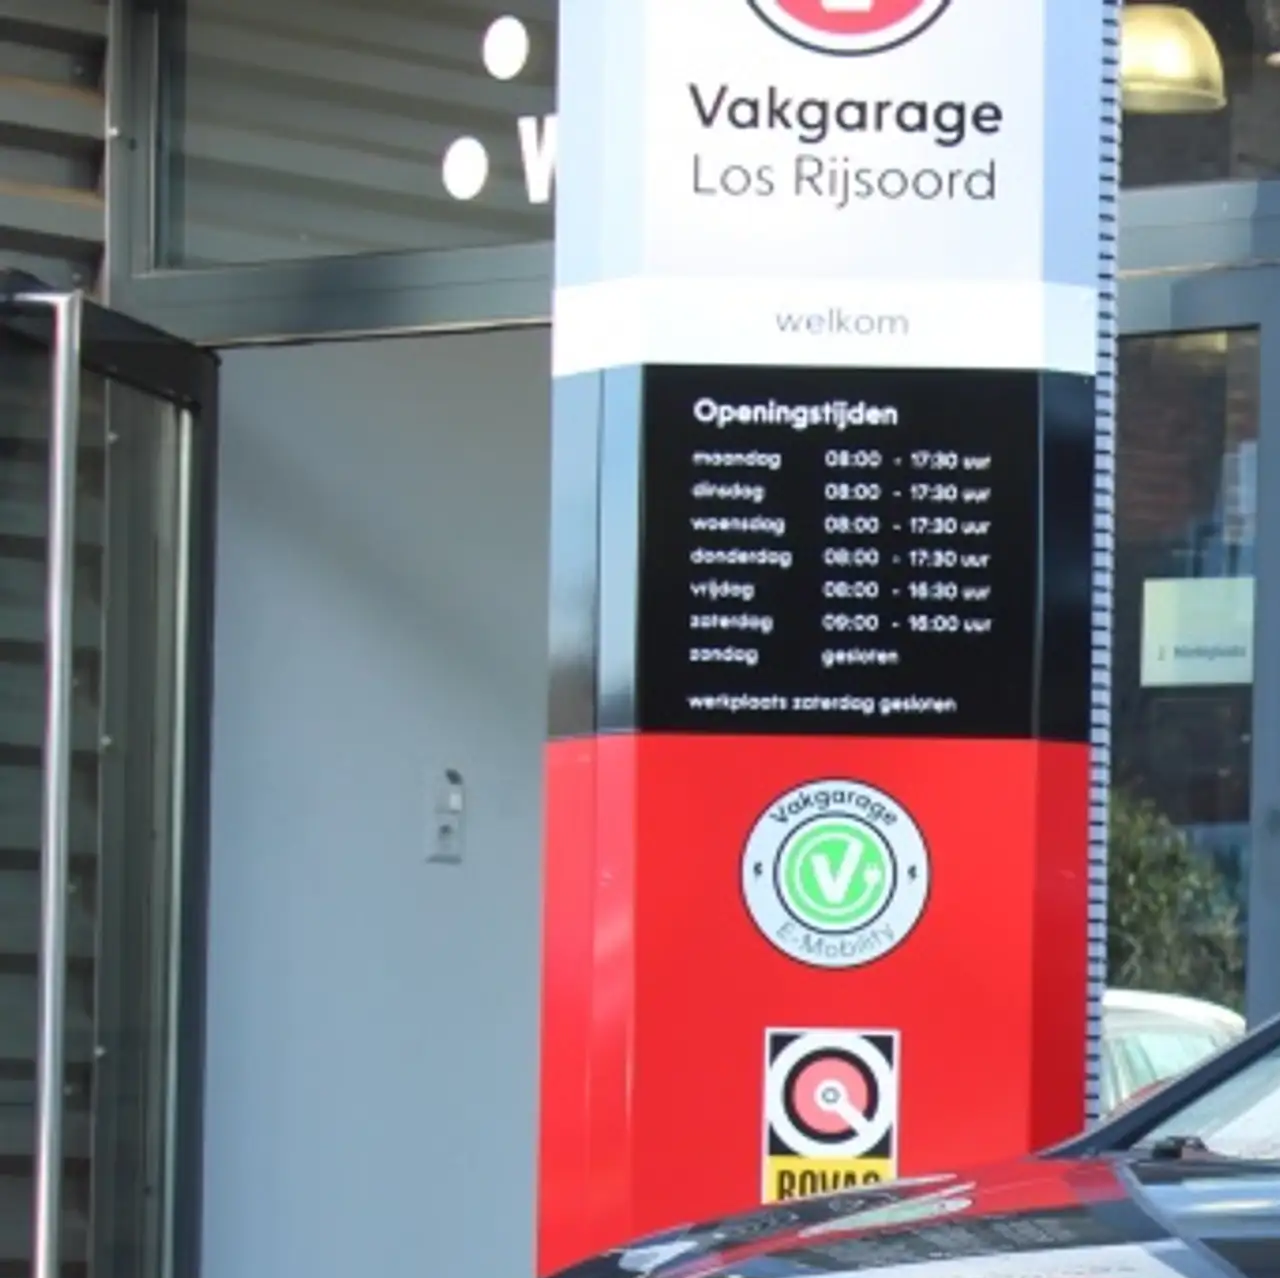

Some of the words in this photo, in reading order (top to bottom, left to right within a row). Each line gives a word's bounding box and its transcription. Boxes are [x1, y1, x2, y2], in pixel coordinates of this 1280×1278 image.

[689, 83, 1003, 147] Vakgarage
[692, 153, 775, 197] Los
[793, 156, 996, 208] Rijsoord
[775, 307, 910, 337] welkom
[693, 397, 898, 431] Openingstijden
[692, 450, 781, 470] maandag
[825, 450, 882, 468] 08:00
[910, 450, 958, 469] 17:30
[962, 455, 991, 470] uur
[691, 482, 765, 503] dinsdag
[825, 482, 881, 500] 08:00
[910, 483, 958, 501] 17:30
[962, 487, 991, 503] uur
[690, 516, 785, 536] woensdag
[824, 515, 879, 533] 08:00
[910, 517, 957, 534] 17:30
[961, 521, 991, 534] uur
[690, 548, 792, 568] donderdag
[909, 549, 957, 567] 17:30
[961, 554, 990, 567] uur
[690, 580, 755, 601] vrijdag
[962, 586, 990, 600] uur
[690, 614, 773, 634] zaterdag
[822, 614, 879, 631] 09:00
[964, 618, 991, 632] uur
[690, 646, 758, 666] zondag
[821, 648, 898, 667] gesloten
[688, 694, 788, 712] werkplaats
[791, 694, 875, 714] zaterdag
[877, 696, 957, 715] gesloten
[769, 789, 898, 827] Vakgarage
[776, 922, 895, 959] E-Mobility
